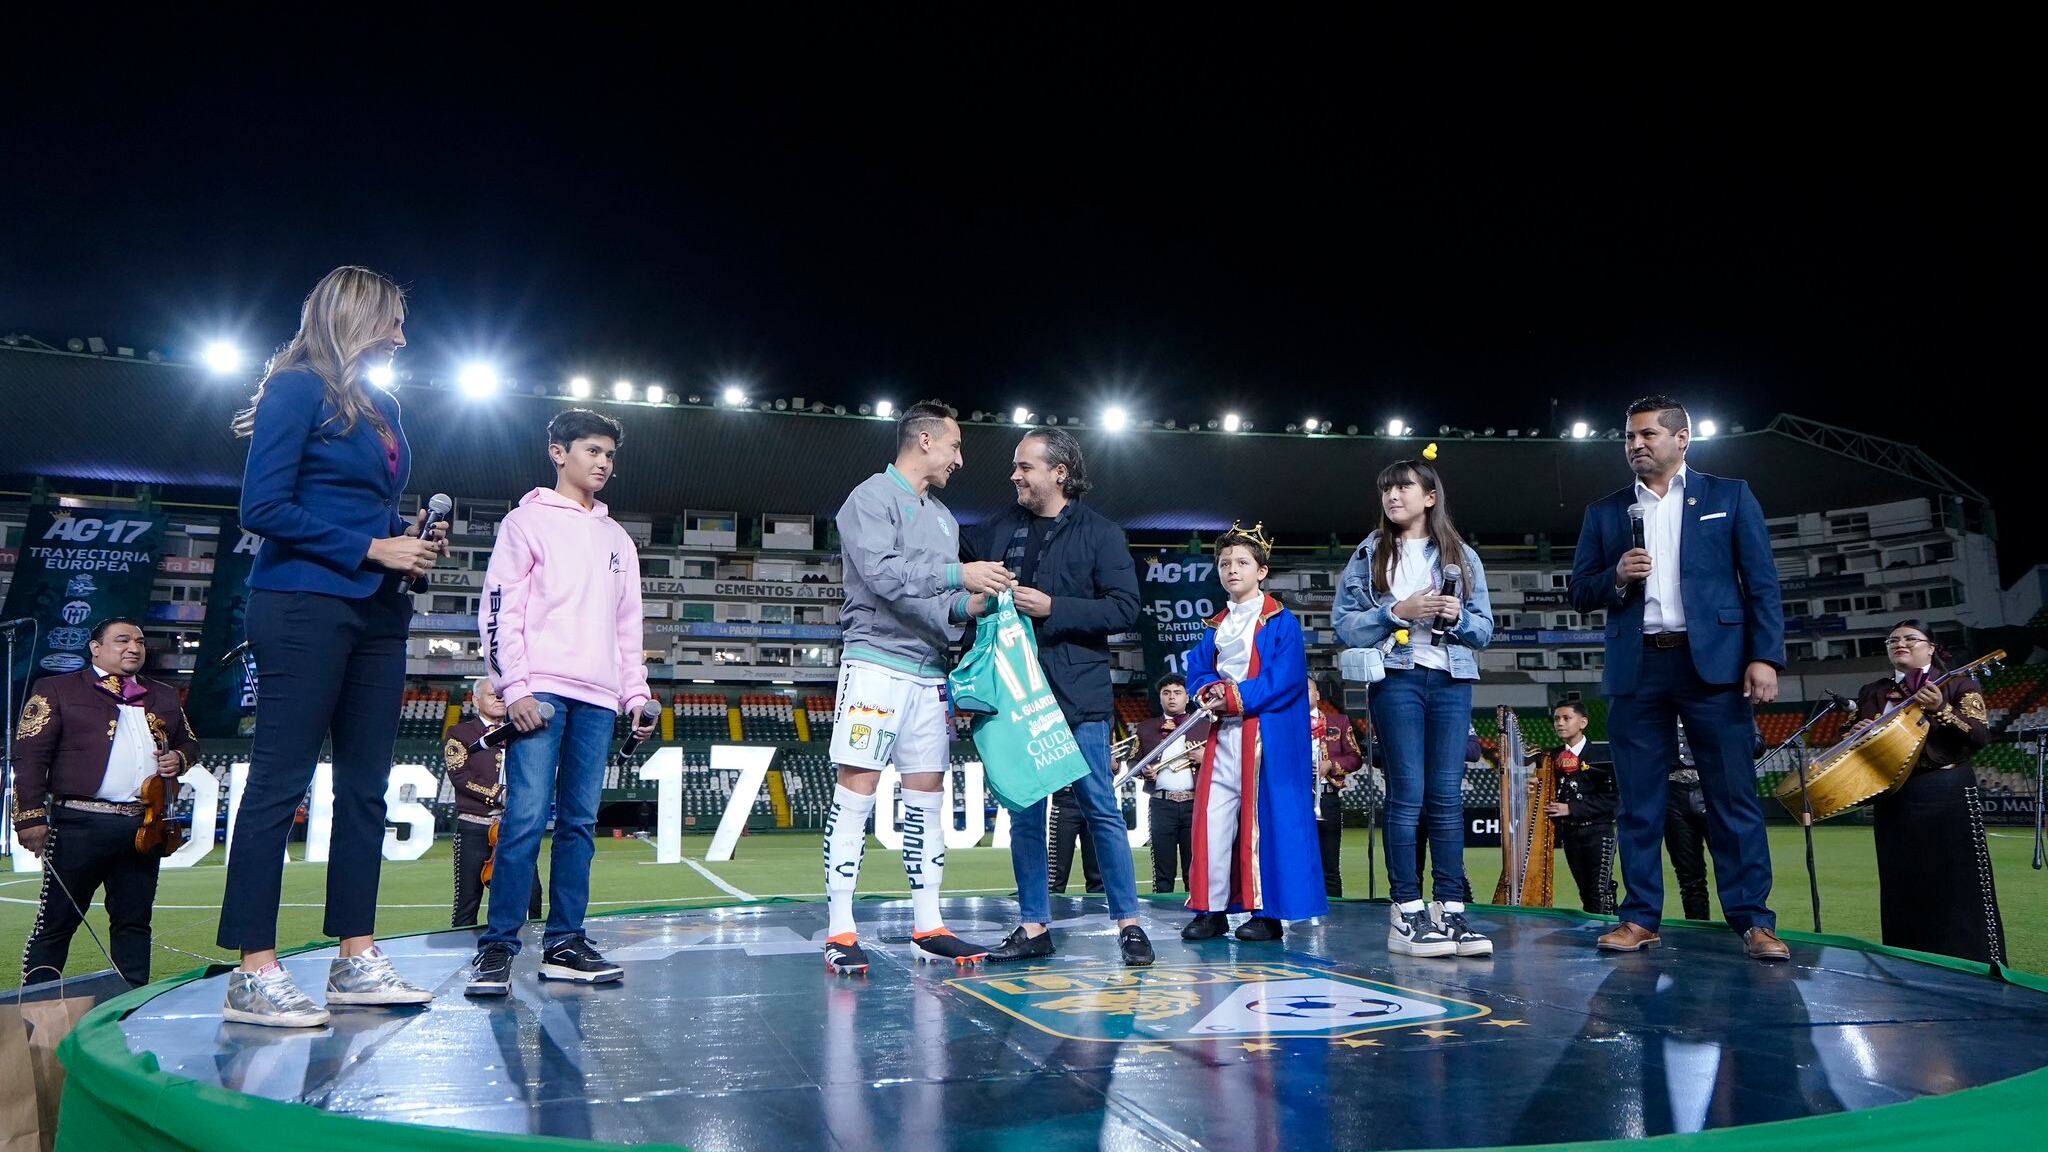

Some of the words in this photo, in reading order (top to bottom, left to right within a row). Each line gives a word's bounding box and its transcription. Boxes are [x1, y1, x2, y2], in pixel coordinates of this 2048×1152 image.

[43, 517, 152, 544] AG17
[30, 547, 150, 563] TRAYECTORIA
[45, 558, 130, 573] EUROPEA
[1145, 563, 1214, 583] AG17
[427, 573, 471, 585] LEZA
[715, 584, 794, 597] CEMENTOS
[1142, 598, 1214, 623] +500
[655, 624, 691, 633] CHARLY
[1158, 633, 1173, 642] EN
[873, 729, 897, 762] 17
[639, 745, 777, 864] 17
